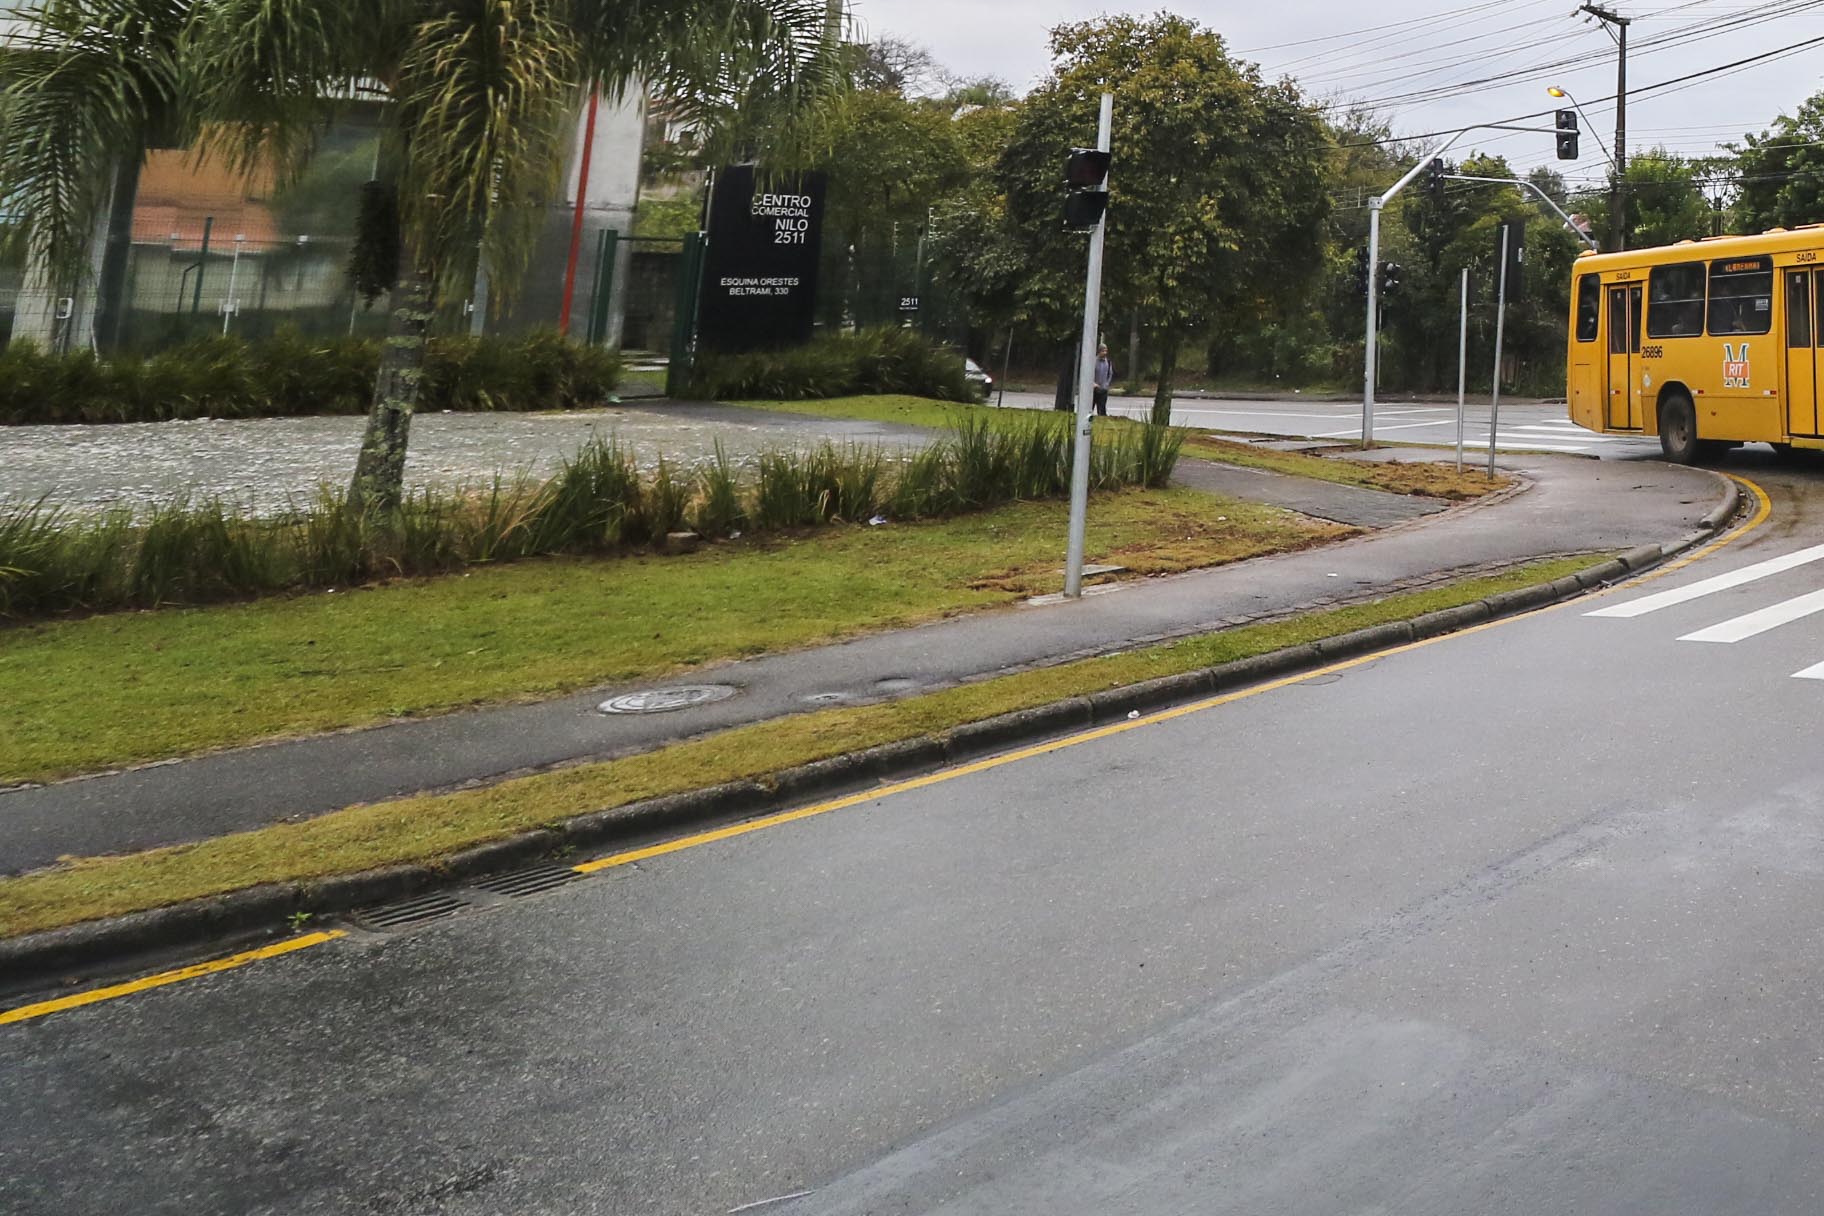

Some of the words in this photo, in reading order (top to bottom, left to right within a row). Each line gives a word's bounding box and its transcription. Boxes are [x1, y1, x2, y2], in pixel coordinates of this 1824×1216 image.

[752, 193, 811, 208] CENTRO
[752, 206, 809, 217] COMERCIAL
[775, 218, 809, 231] NILO
[774, 231, 805, 244] 2511
[720, 277, 759, 286] ESQUINA
[760, 277, 799, 286] ORESTES
[901, 297, 918, 306] 2511
[1641, 346, 1663, 359] 26896
[1728, 363, 1745, 377] RIT
